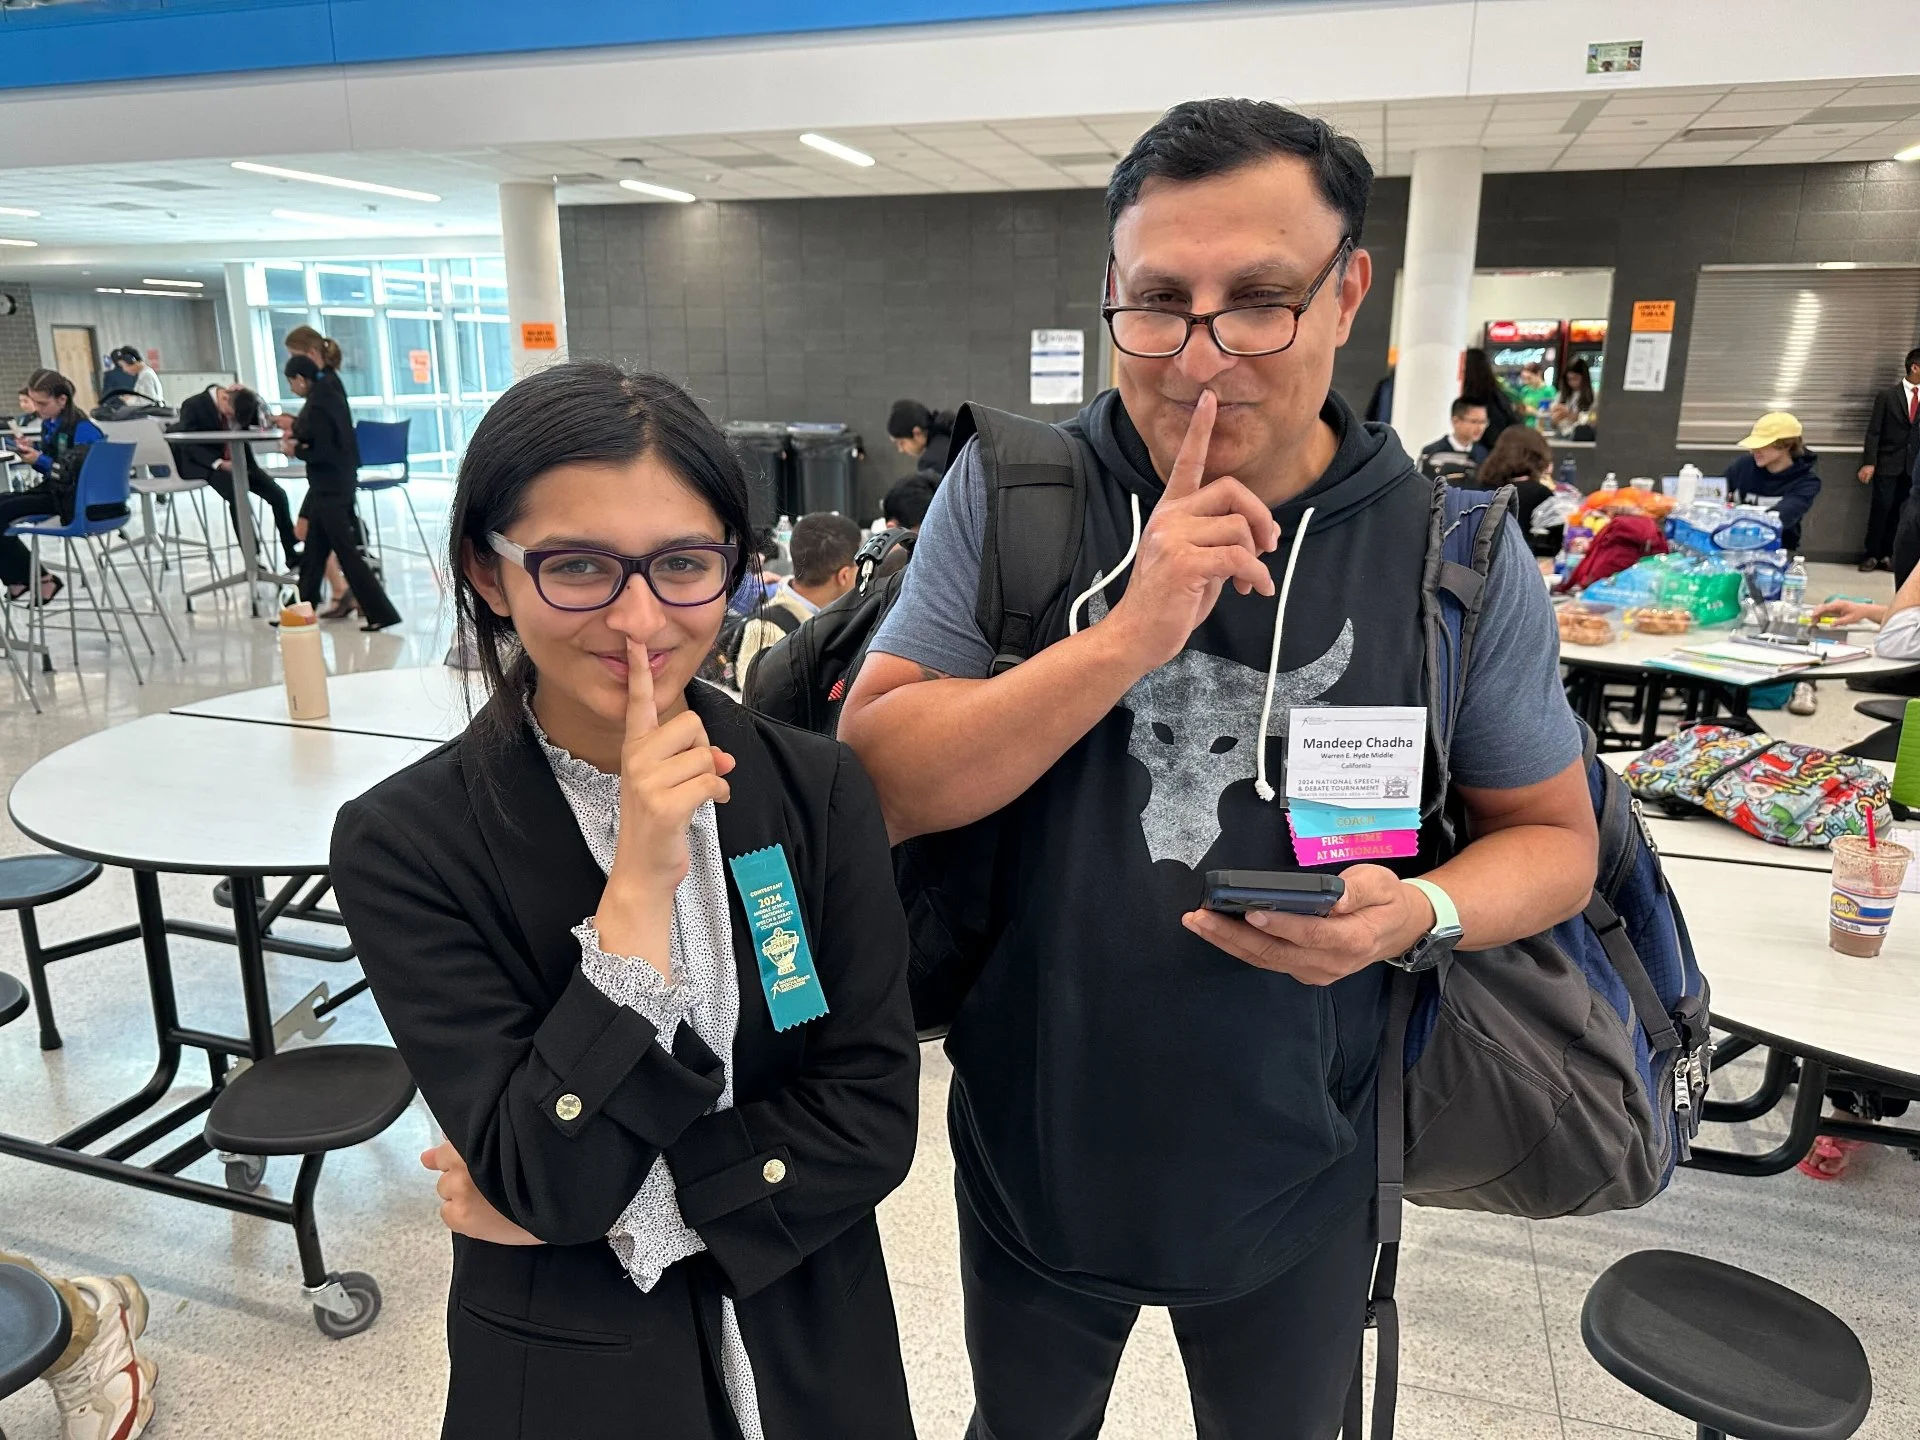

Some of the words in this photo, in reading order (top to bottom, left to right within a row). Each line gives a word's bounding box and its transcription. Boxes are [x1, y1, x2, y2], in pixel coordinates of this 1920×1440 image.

[1303, 737, 1362, 750] Mandeep
[1366, 736, 1413, 748] Chadha
[1353, 752, 1369, 760] Hyde
[1336, 815, 1376, 827] COACH
[1321, 835, 1350, 846] FIRST
[1355, 832, 1383, 843] TIME
[1316, 850, 1328, 861] AT
[1330, 845, 1392, 858] NATIONALS
[750, 882, 783, 897] CONTESTANT
[757, 893, 782, 908] 2024
[753, 906, 771, 917] MIDDLE
[771, 900, 790, 911] SCHOOL
[761, 908, 785, 919] NATIONAL
[760, 916, 792, 930] TOURNAMENT
